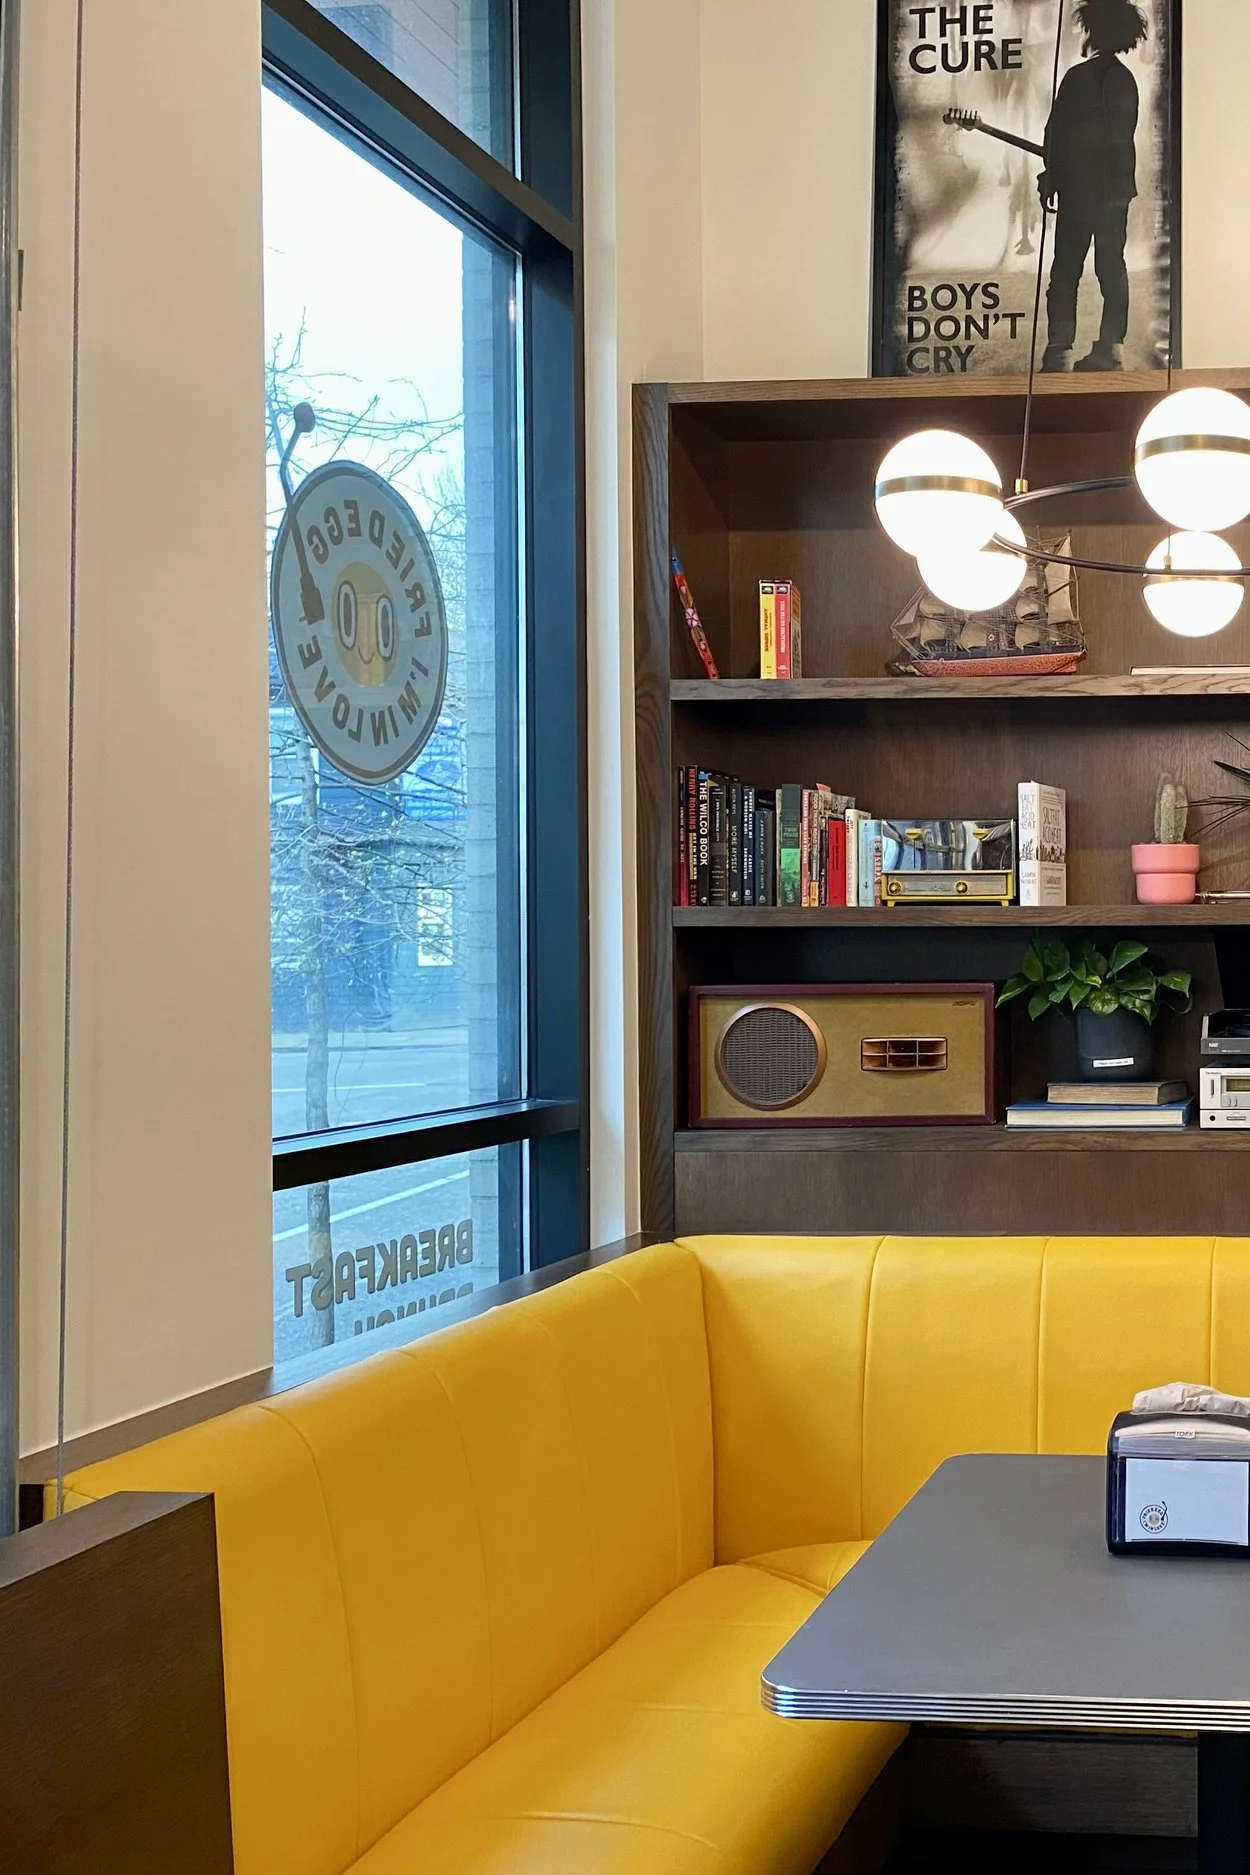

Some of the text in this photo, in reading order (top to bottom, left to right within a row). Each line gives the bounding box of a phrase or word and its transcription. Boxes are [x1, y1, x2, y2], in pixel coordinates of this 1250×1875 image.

[909, 4, 994, 39] THE
[909, 38, 1023, 74] CURE
[907, 282, 1000, 312] BOYS
[906, 312, 1025, 343] DON'T
[906, 344, 975, 374] CRY
[688, 797, 697, 830] ROLLINS
[699, 781, 708, 866] THE WILCO BOOK
